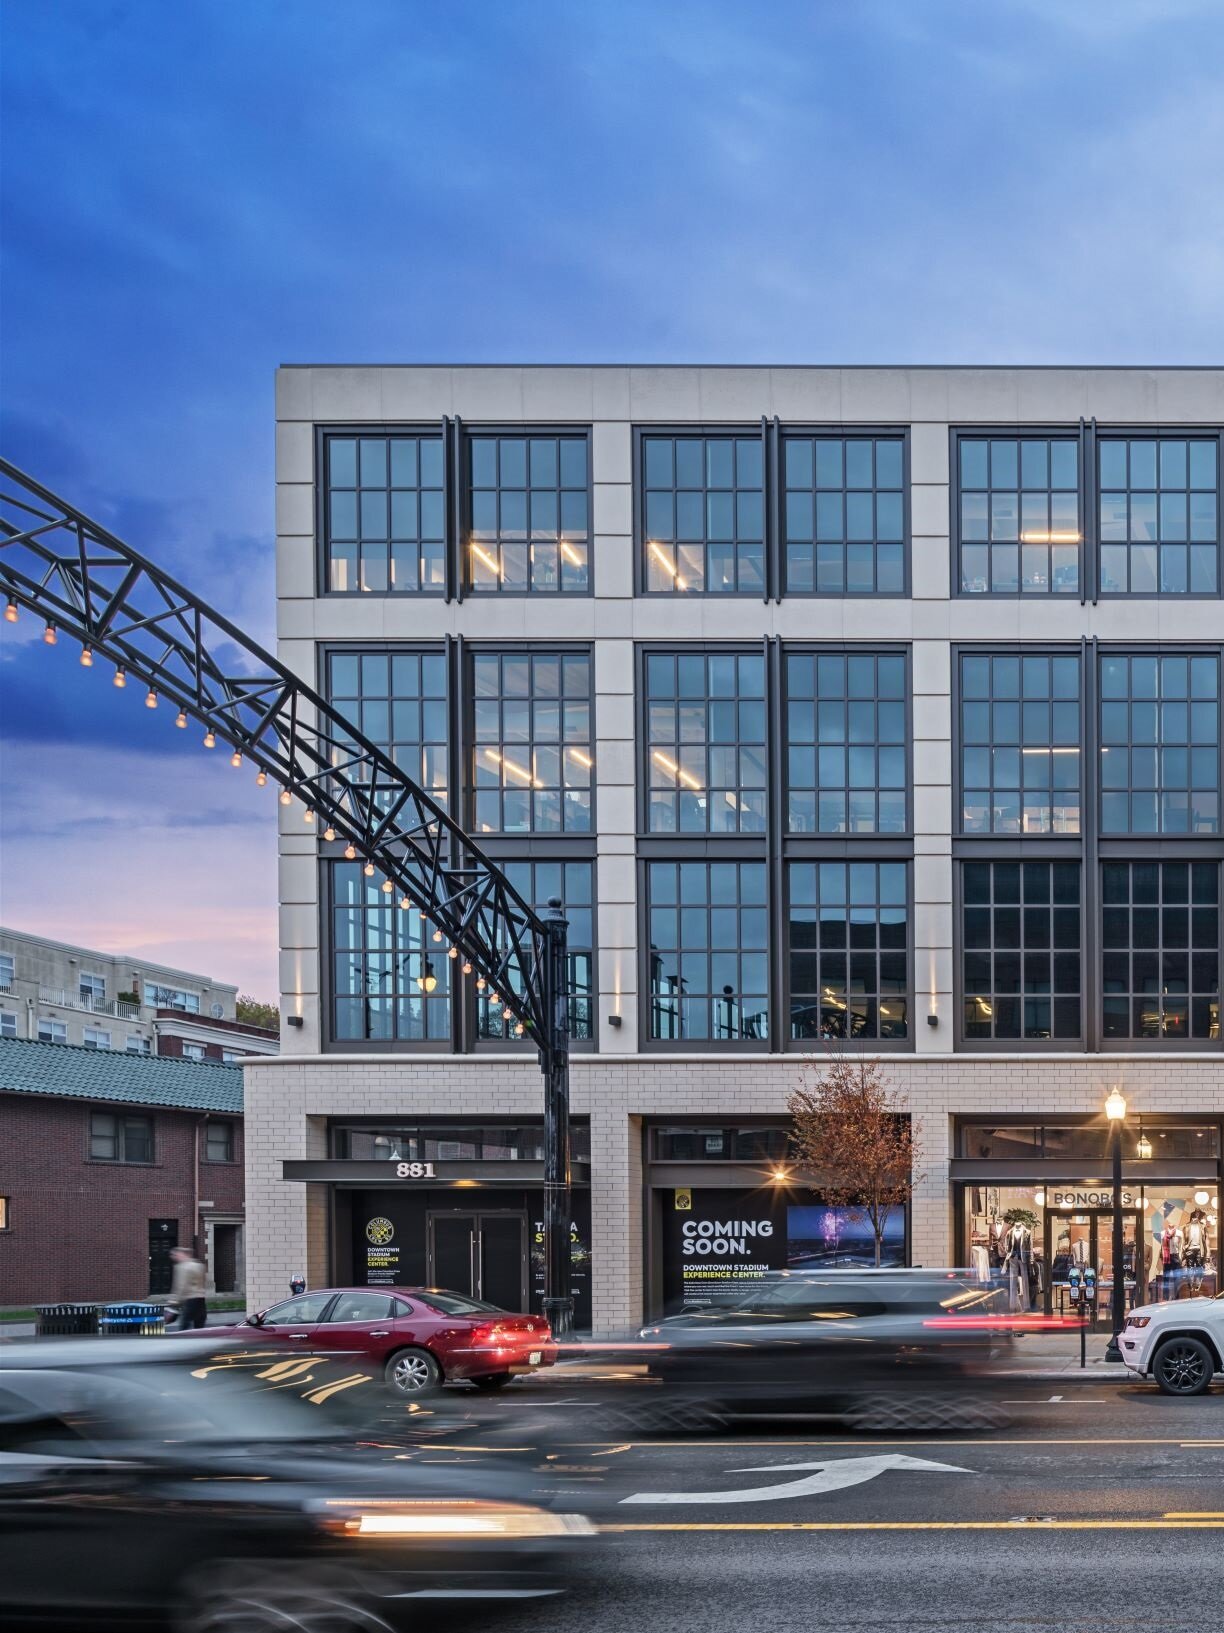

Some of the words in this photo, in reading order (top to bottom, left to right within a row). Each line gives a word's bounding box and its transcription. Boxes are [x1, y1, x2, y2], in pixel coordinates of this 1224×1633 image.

[396, 1162, 437, 1178] 881
[682, 1220, 773, 1237] COMING
[682, 1238, 752, 1255] SOON.
